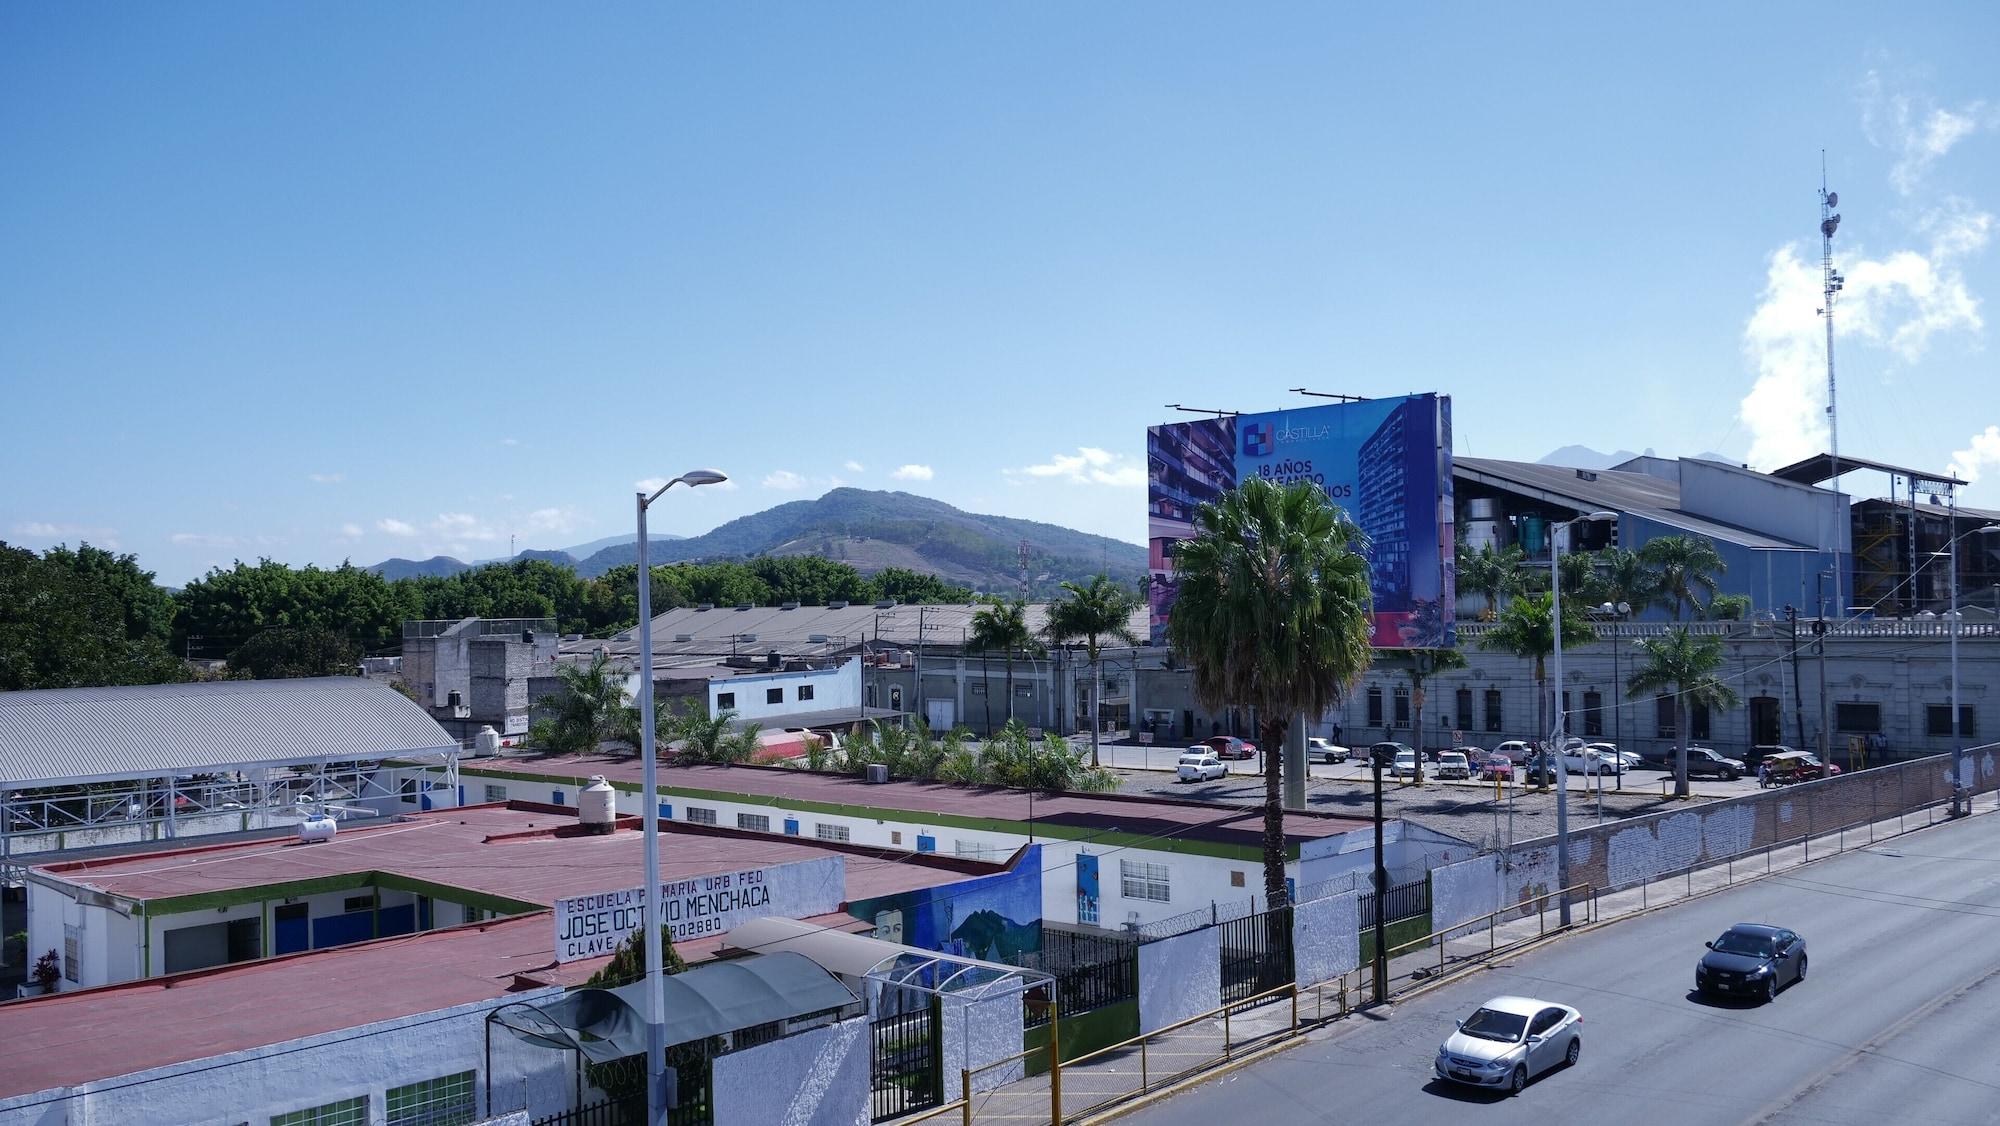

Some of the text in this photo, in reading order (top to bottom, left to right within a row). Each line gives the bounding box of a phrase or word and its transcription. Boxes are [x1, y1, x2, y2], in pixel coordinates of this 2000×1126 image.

[1276, 423, 1329, 441] CASTILLA
[1258, 458, 1312, 477] 18 AÑOS
[567, 870, 763, 913] ESCUELA PMARIA URB FED
[560, 885, 770, 940] JOSE OCTIO MENCHACA
[568, 936, 613, 956] CLAVE
